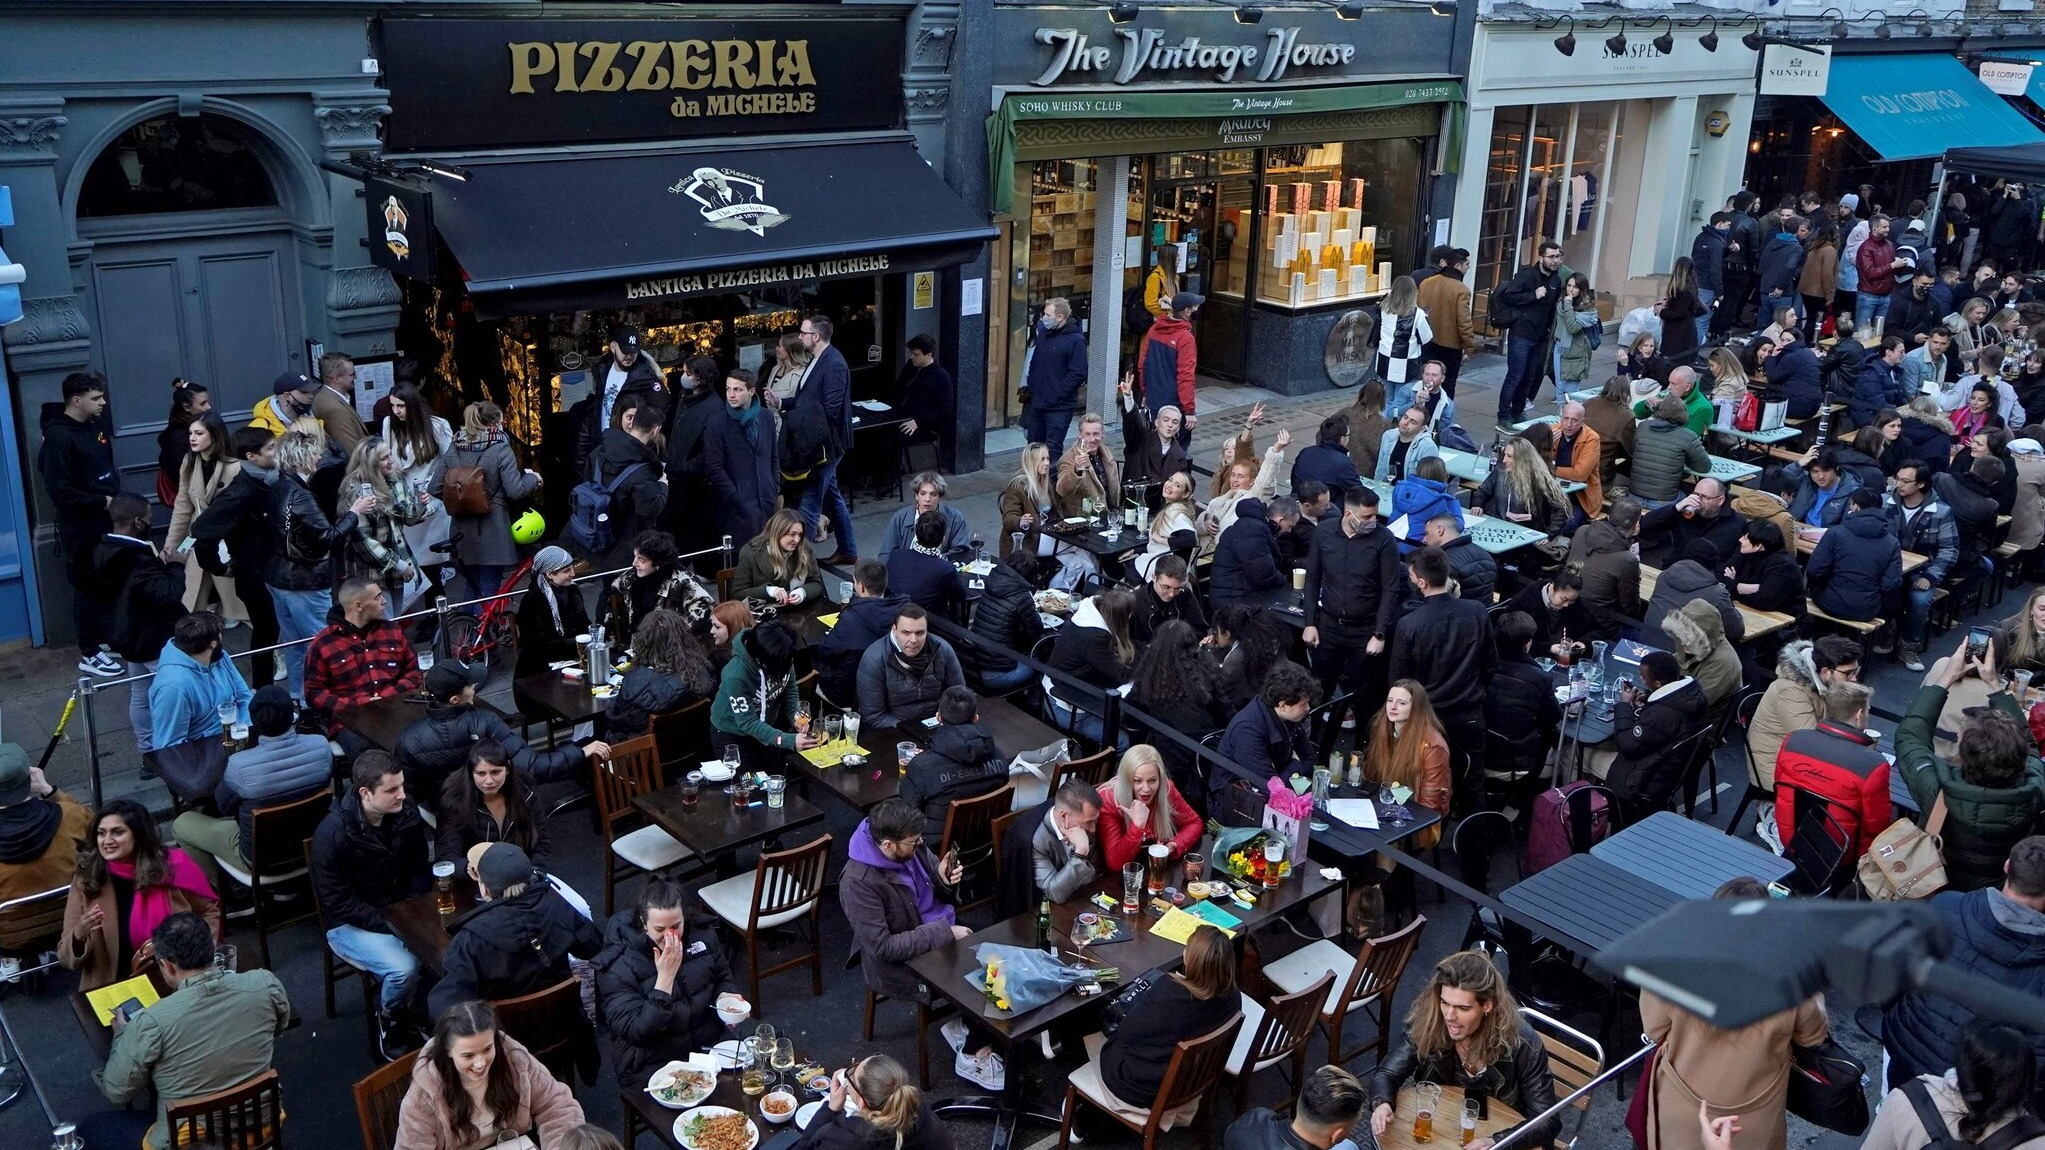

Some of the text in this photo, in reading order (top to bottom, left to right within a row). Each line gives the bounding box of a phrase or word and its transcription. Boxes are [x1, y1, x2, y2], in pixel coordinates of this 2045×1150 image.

[1030, 26, 1356, 87] The Vintage House
[509, 39, 816, 94] PIZZERIA
[1769, 69, 1821, 77] SUNSPEL
[1997, 71, 2028, 80] COMPTON
[671, 92, 816, 117] da MICHELE
[1020, 99, 1123, 113] SOHO WHISKY CLUB
[1232, 96, 1293, 110] The Vintage House
[1861, 89, 1971, 114] OLD COMPTON
[1224, 134, 1263, 144] EMBASSY
[720, 168, 765, 184] Pizzeria
[626, 254, 889, 299] LANTICA PIZZERIA DA MICHELE
[370, 341, 386, 354] 44
[1336, 350, 1367, 363] WHISKY
[729, 695, 749, 714] 23
